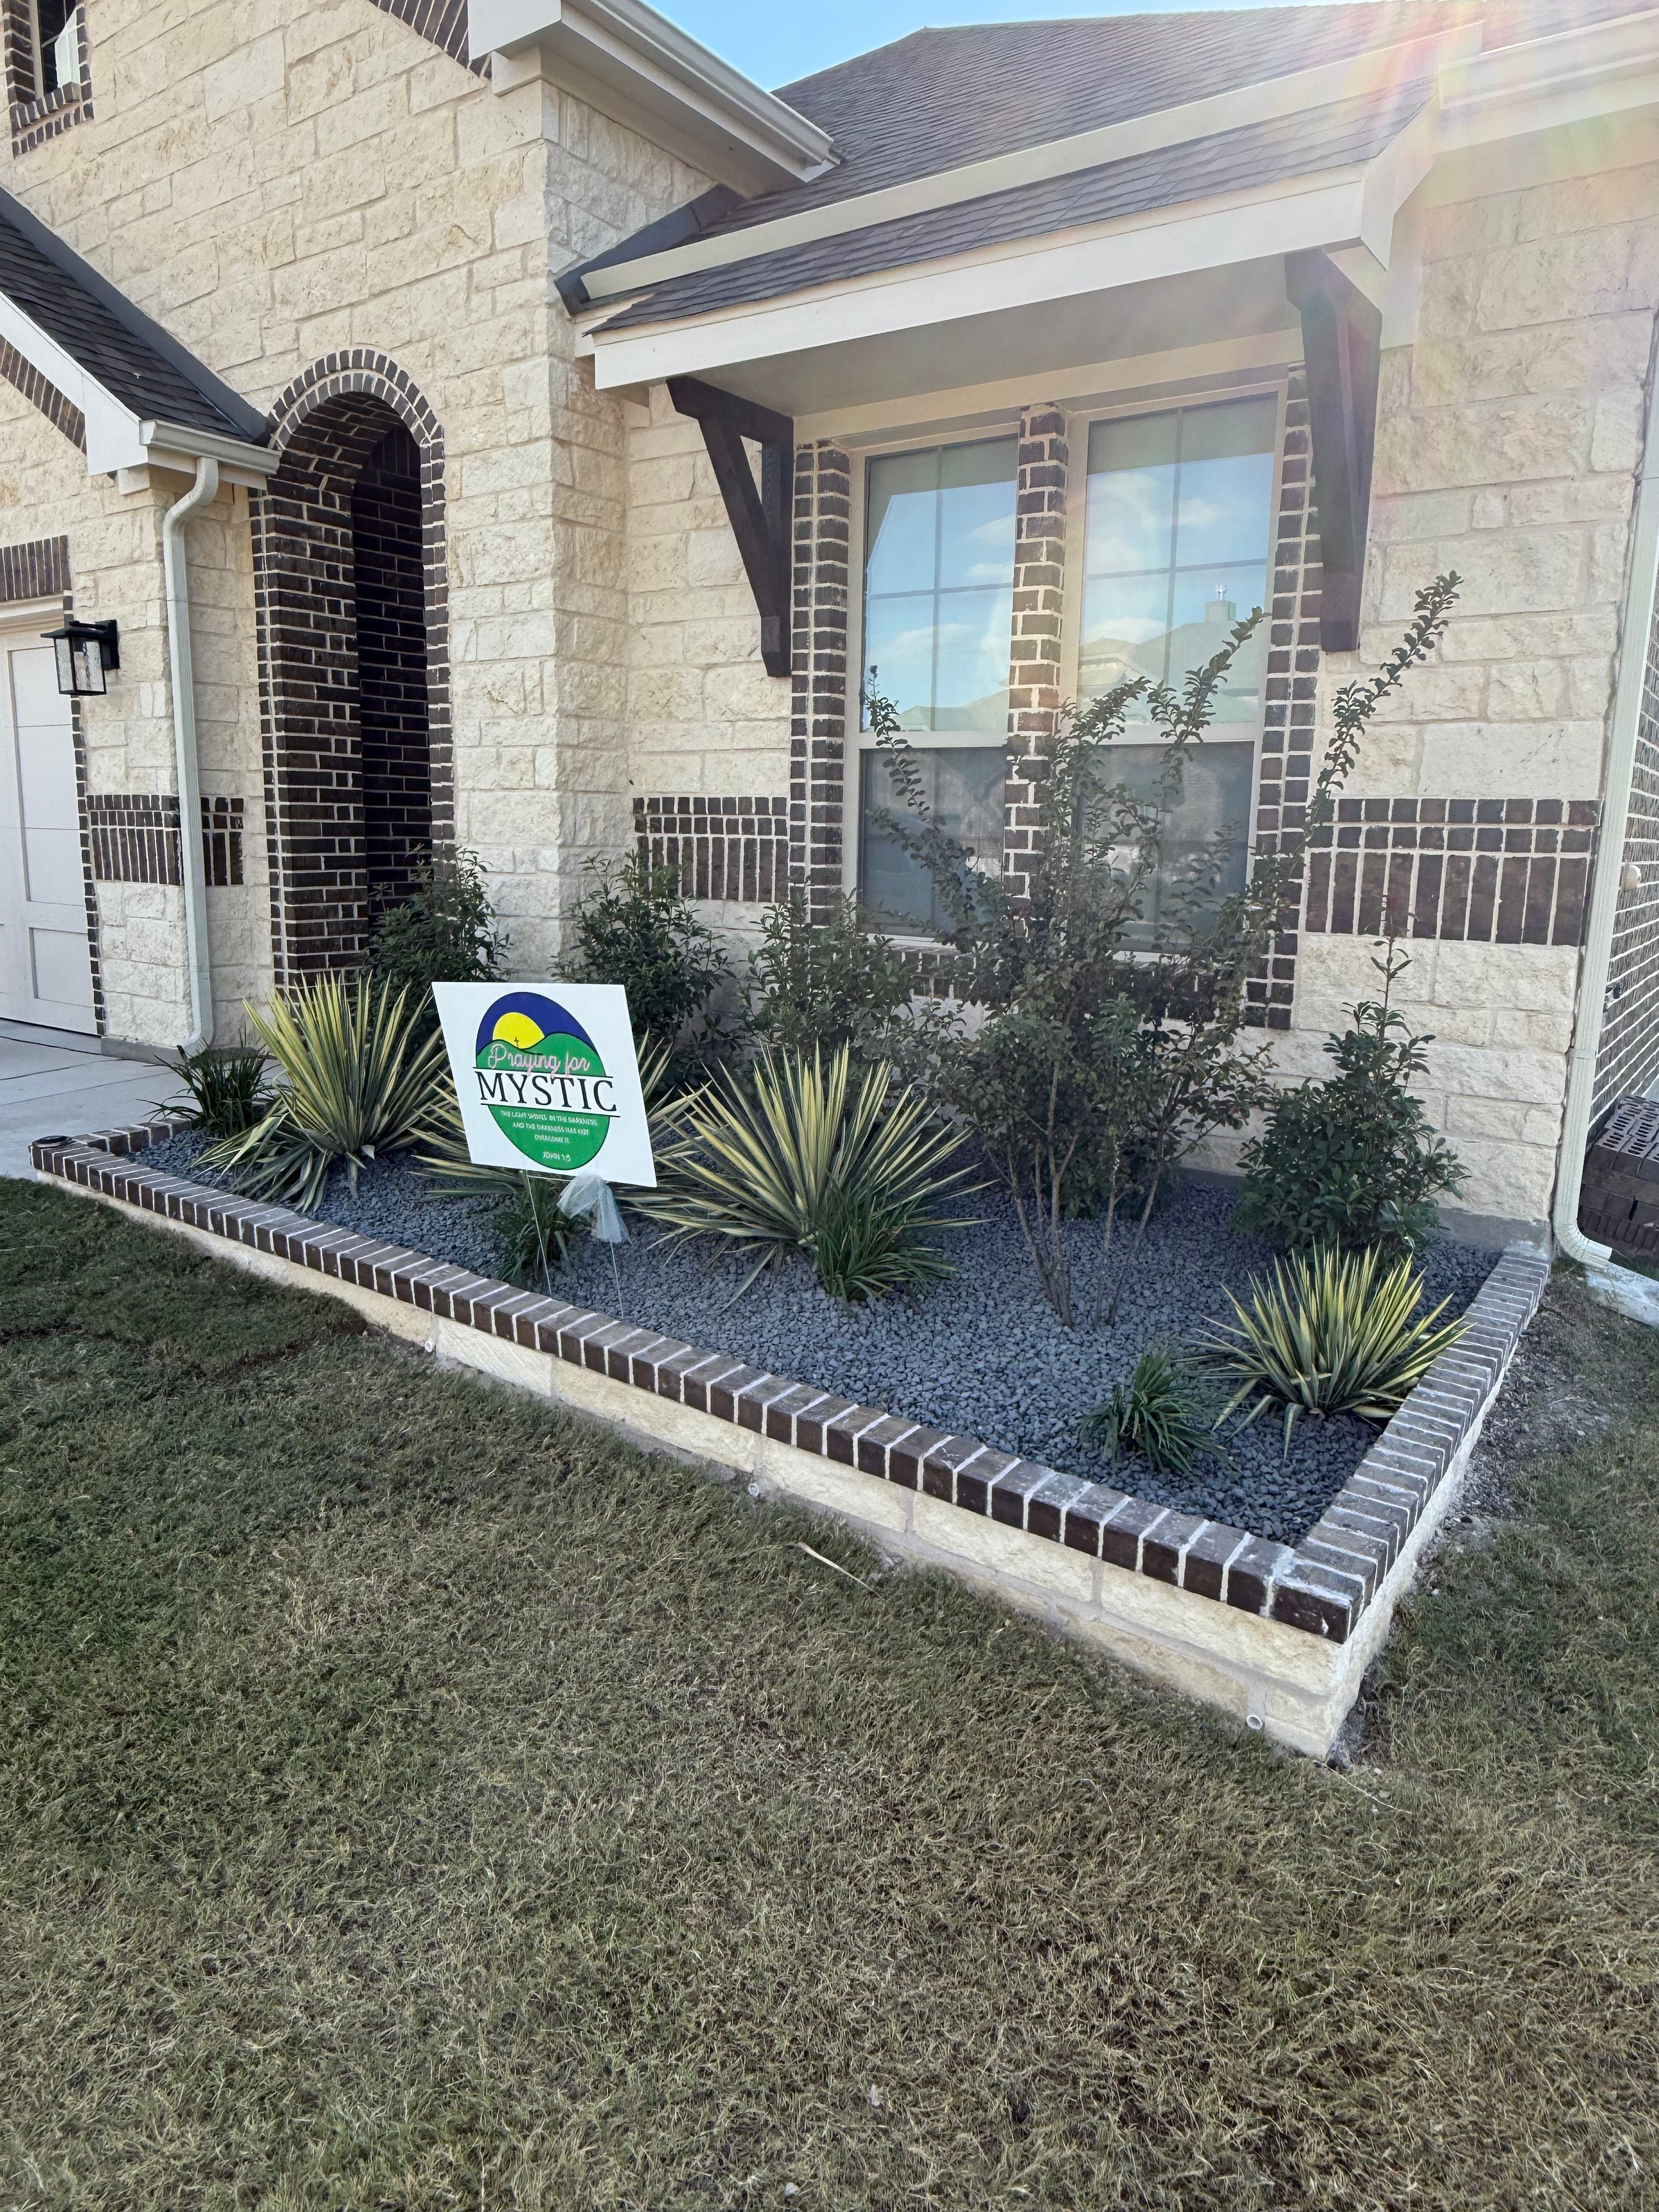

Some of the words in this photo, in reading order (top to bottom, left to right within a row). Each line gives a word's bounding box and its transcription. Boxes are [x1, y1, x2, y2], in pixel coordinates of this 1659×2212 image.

[488, 1043, 561, 1079] Praying
[565, 1051, 590, 1078] for
[475, 1071, 617, 1111] MYSTIC
[543, 1152, 560, 1160] JOHN
